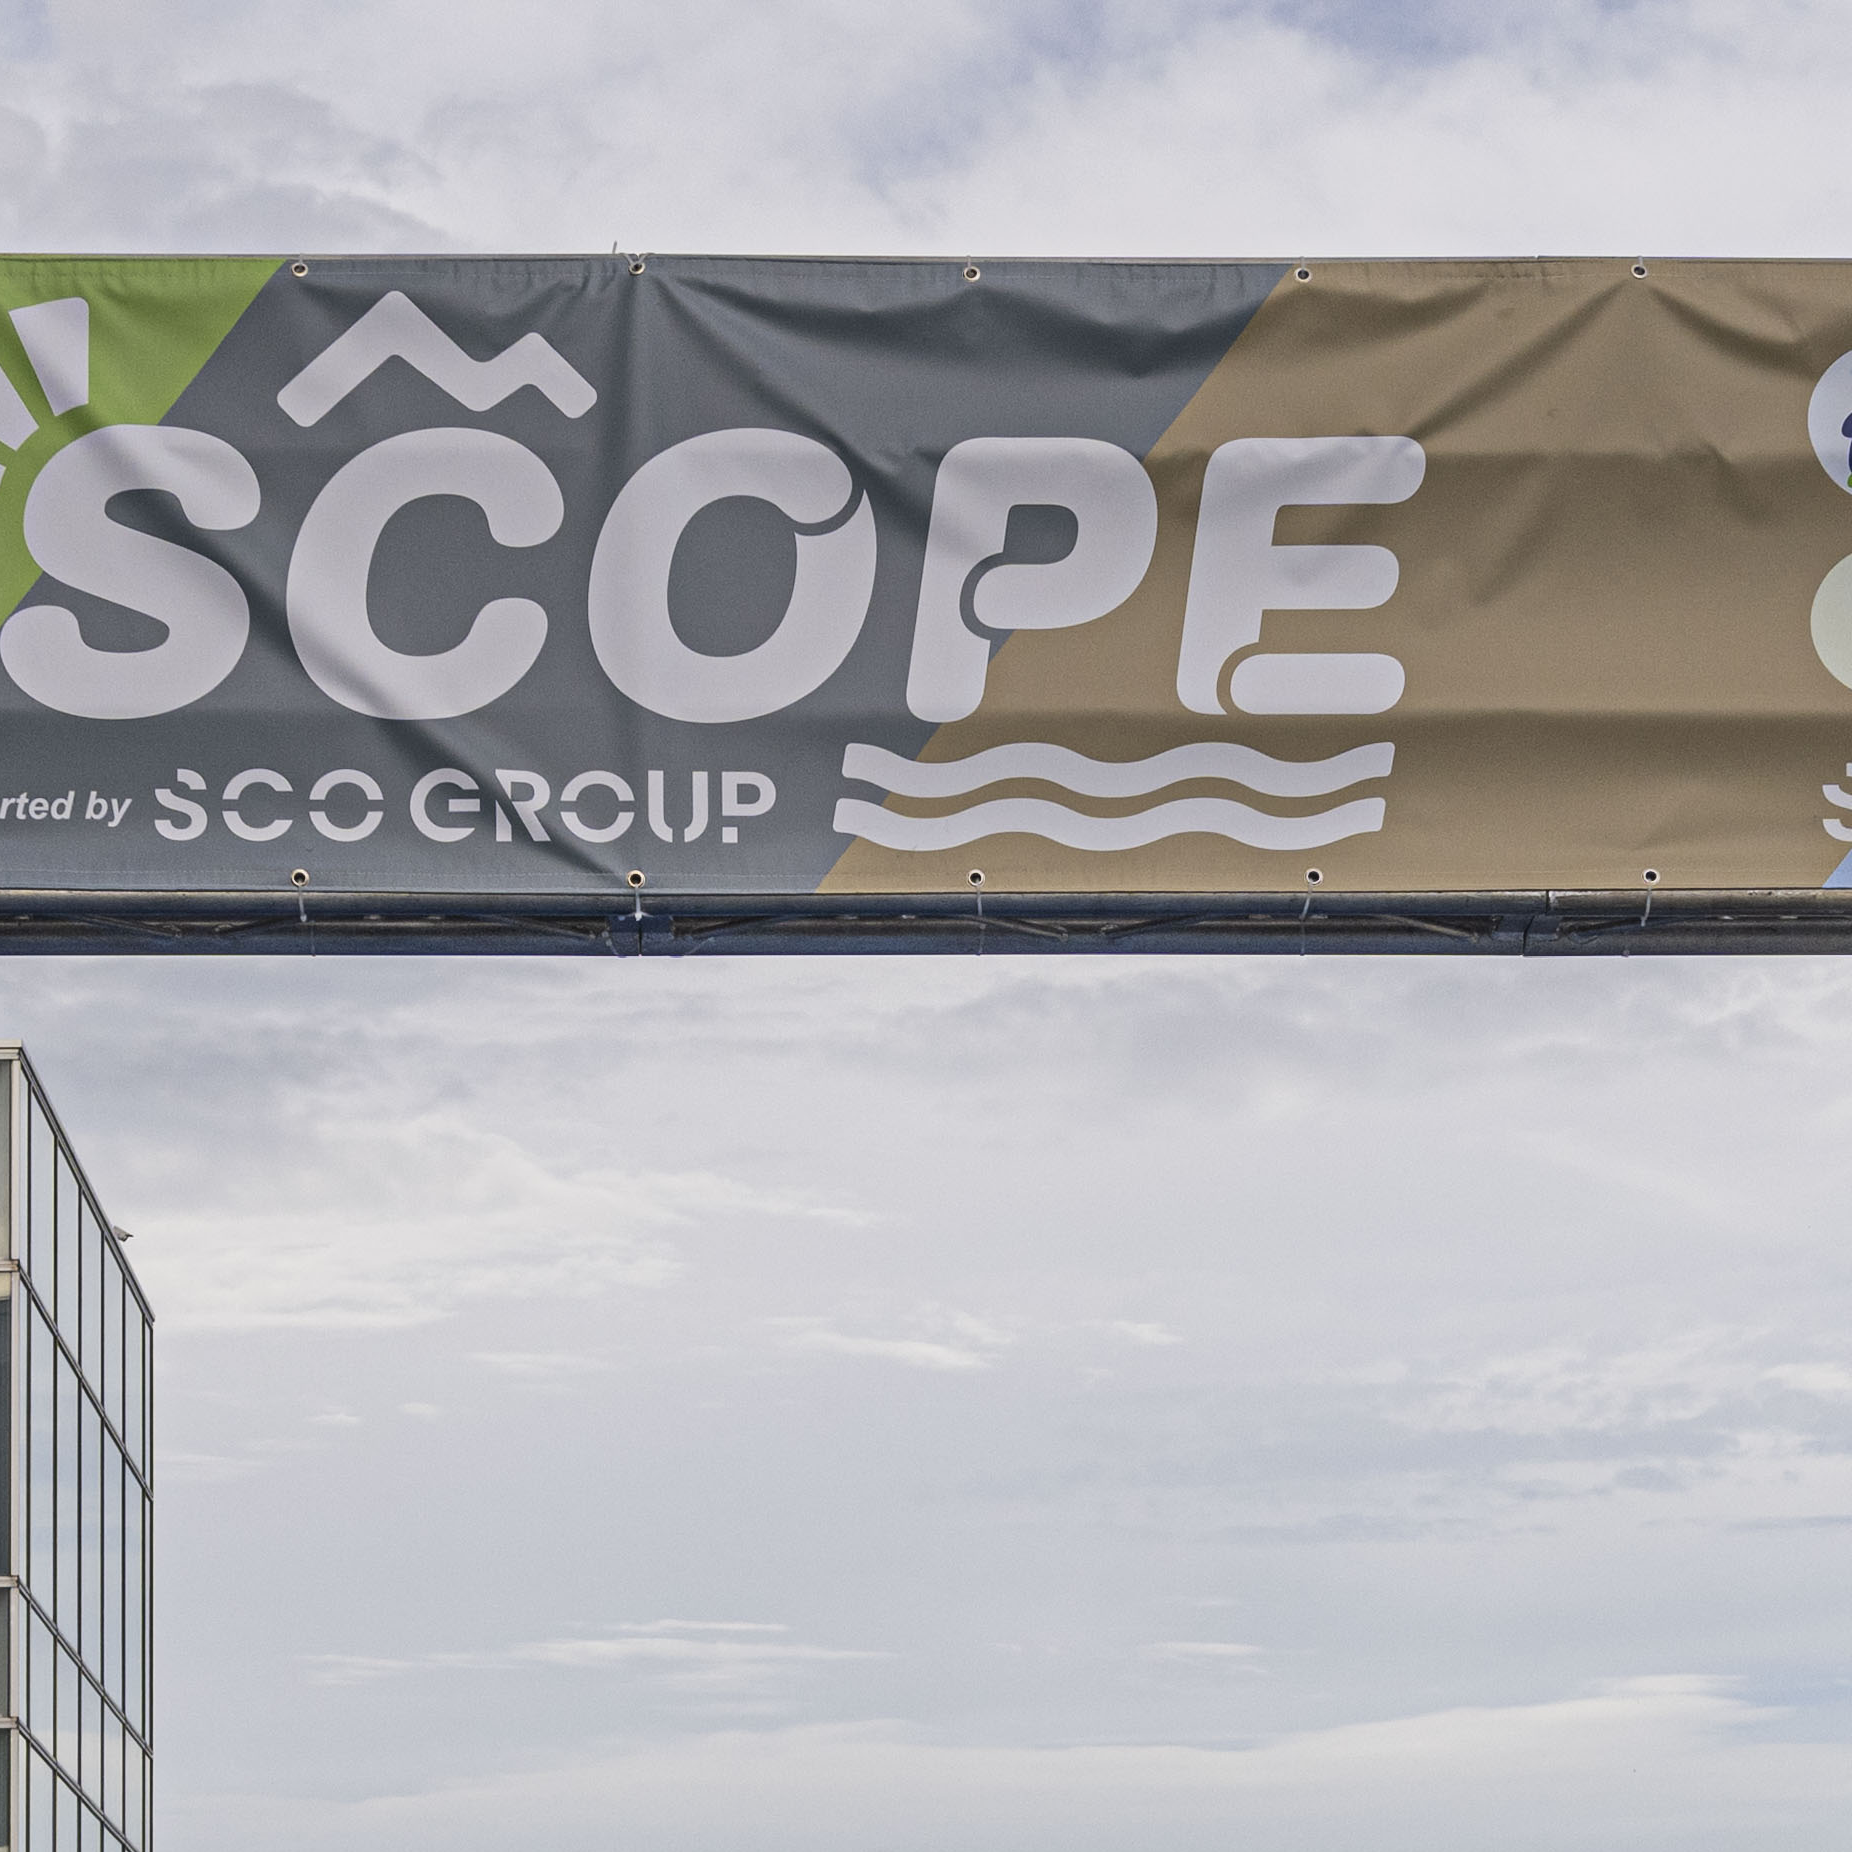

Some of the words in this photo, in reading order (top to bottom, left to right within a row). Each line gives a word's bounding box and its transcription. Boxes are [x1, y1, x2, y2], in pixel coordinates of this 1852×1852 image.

[86, 790, 132, 829] by
[152, 767, 386, 843] SCO
[409, 768, 778, 845] GROUP
